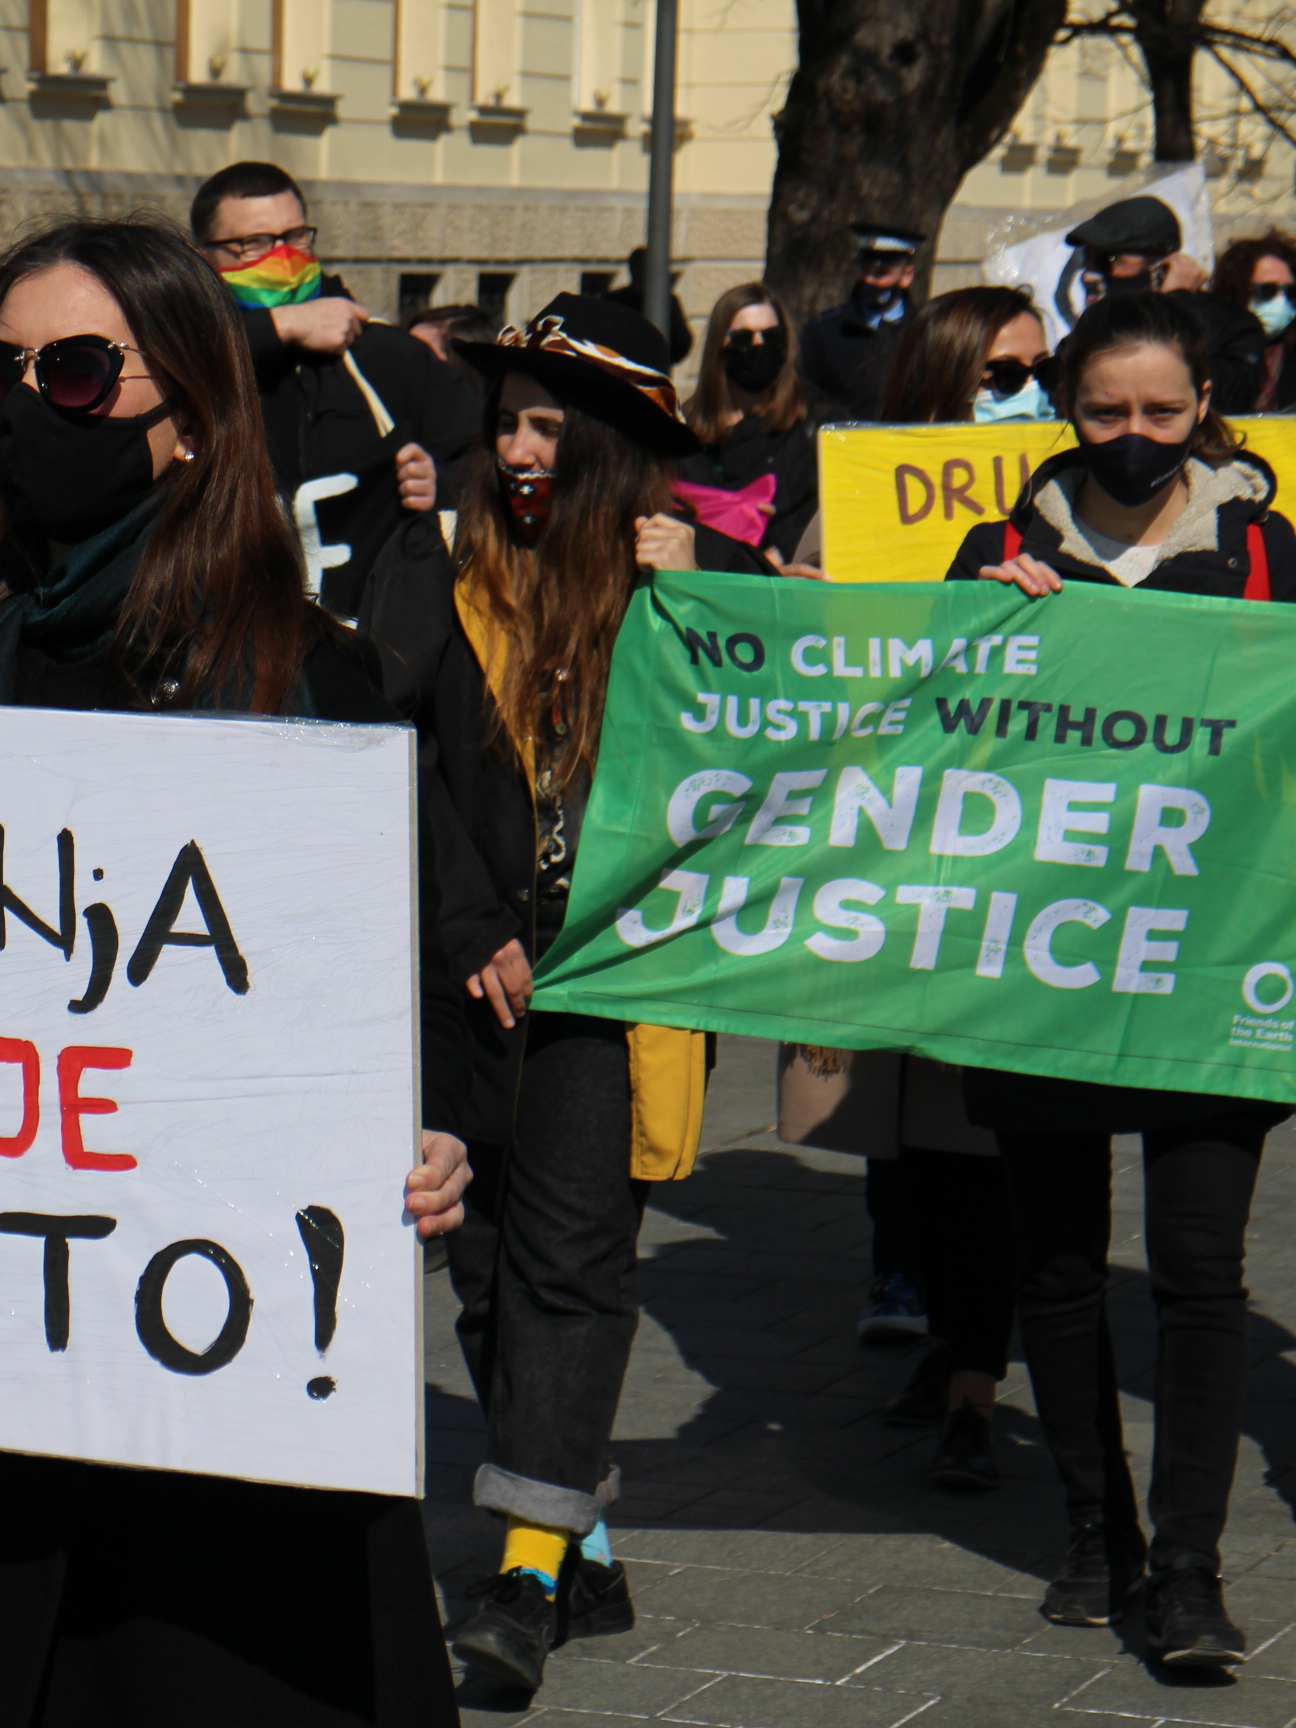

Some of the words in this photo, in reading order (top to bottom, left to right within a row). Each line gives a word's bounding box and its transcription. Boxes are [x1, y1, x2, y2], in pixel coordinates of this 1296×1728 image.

[683, 626, 766, 673] NO
[790, 634, 1040, 678] CLIMATE
[680, 692, 913, 741] JUSTICE
[935, 697, 1238, 756] WITHOUT
[665, 765, 1212, 877] GENDER
[615, 867, 1190, 995] JUSTICE
[1230, 1026, 1252, 1038] the
[1255, 1028, 1294, 1042] Earth
[1232, 1014, 1279, 1029] Friends
